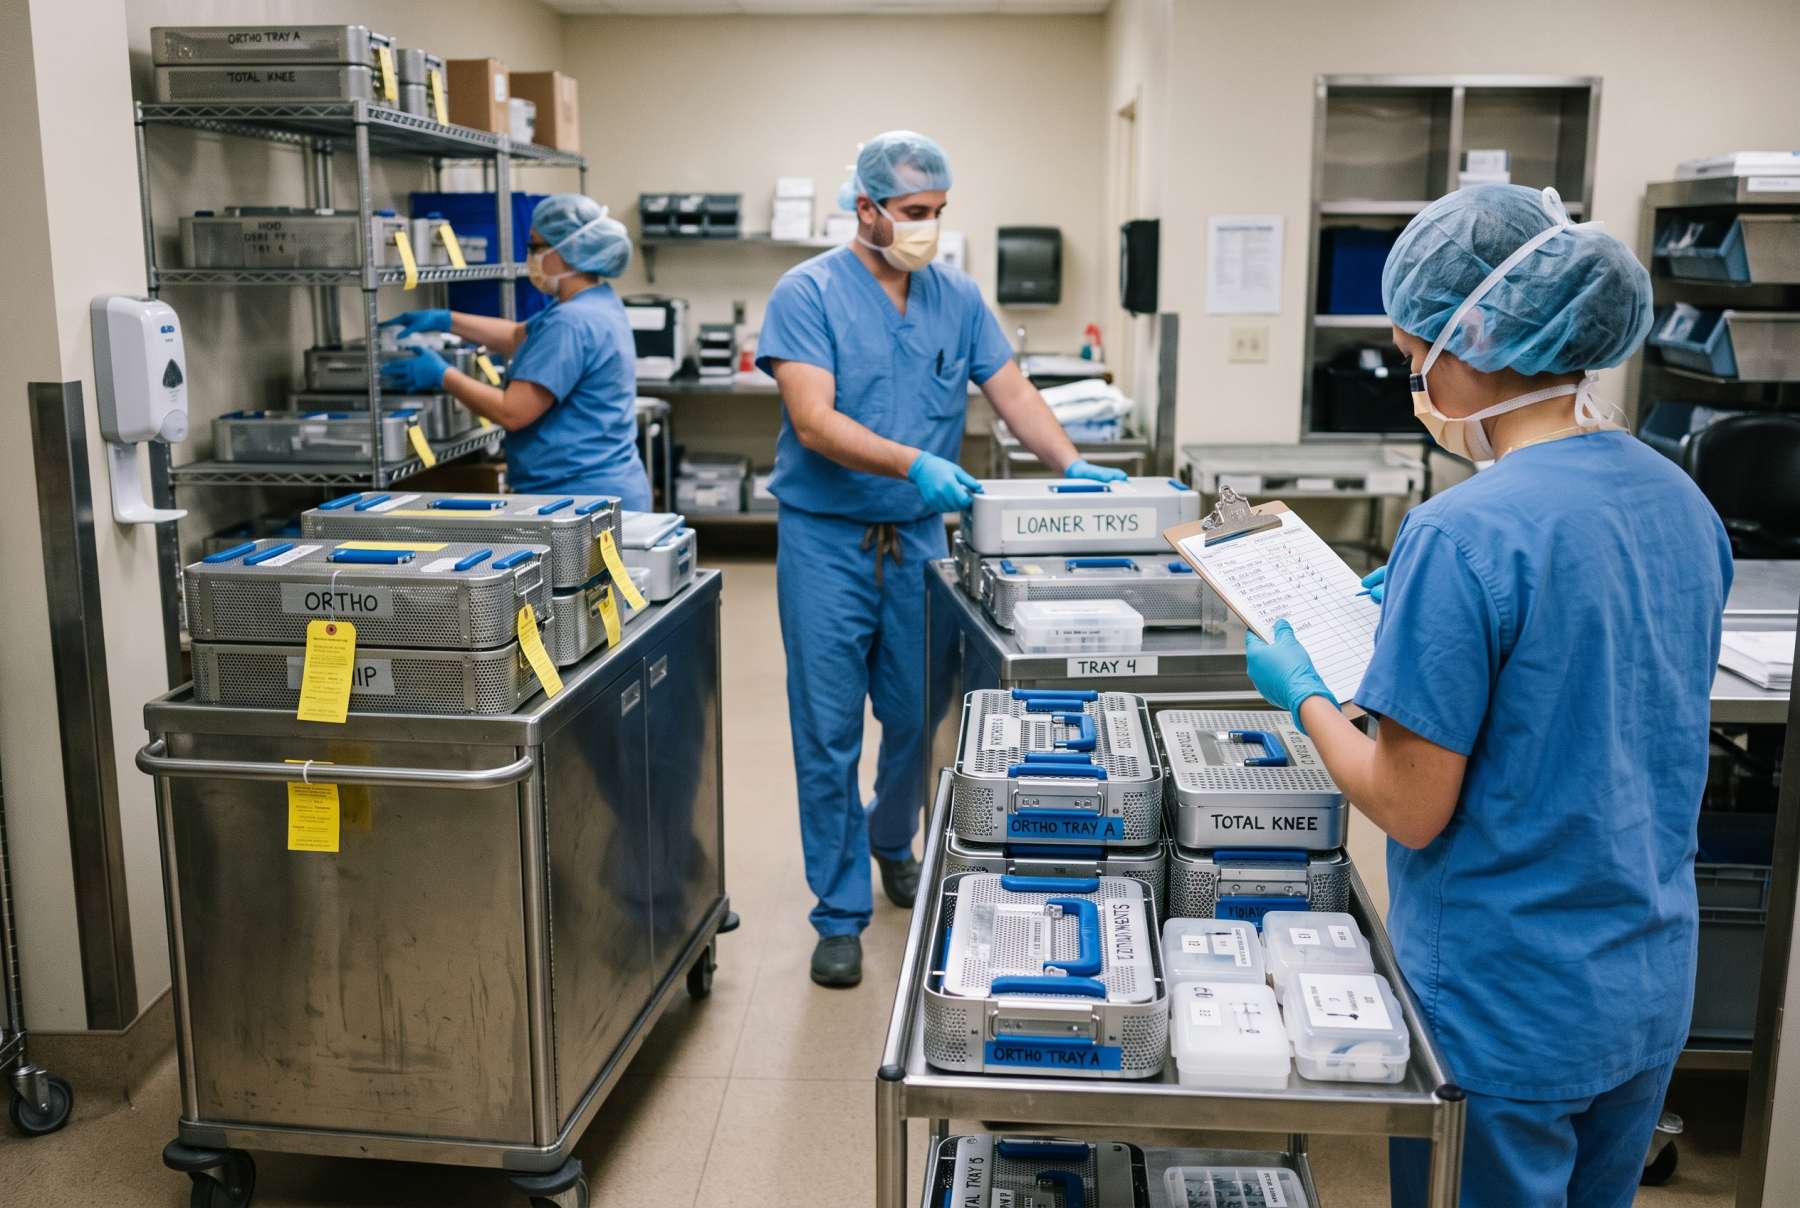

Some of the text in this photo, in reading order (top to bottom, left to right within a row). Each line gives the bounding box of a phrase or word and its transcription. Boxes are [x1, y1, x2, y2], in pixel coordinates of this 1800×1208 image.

[264, 32, 290, 42] TRAY
[226, 71, 297, 82] TOTAL KNEE
[1017, 514, 1140, 535] LOANER TRYS
[304, 591, 379, 612] ORTHO
[1077, 659, 1137, 675] TRAY 4
[1011, 819, 1116, 837] ORTHO TRAY A
[1210, 814, 1318, 831] TOTAL KNEE
[993, 1047, 1101, 1066] ORTHO TRAY A
